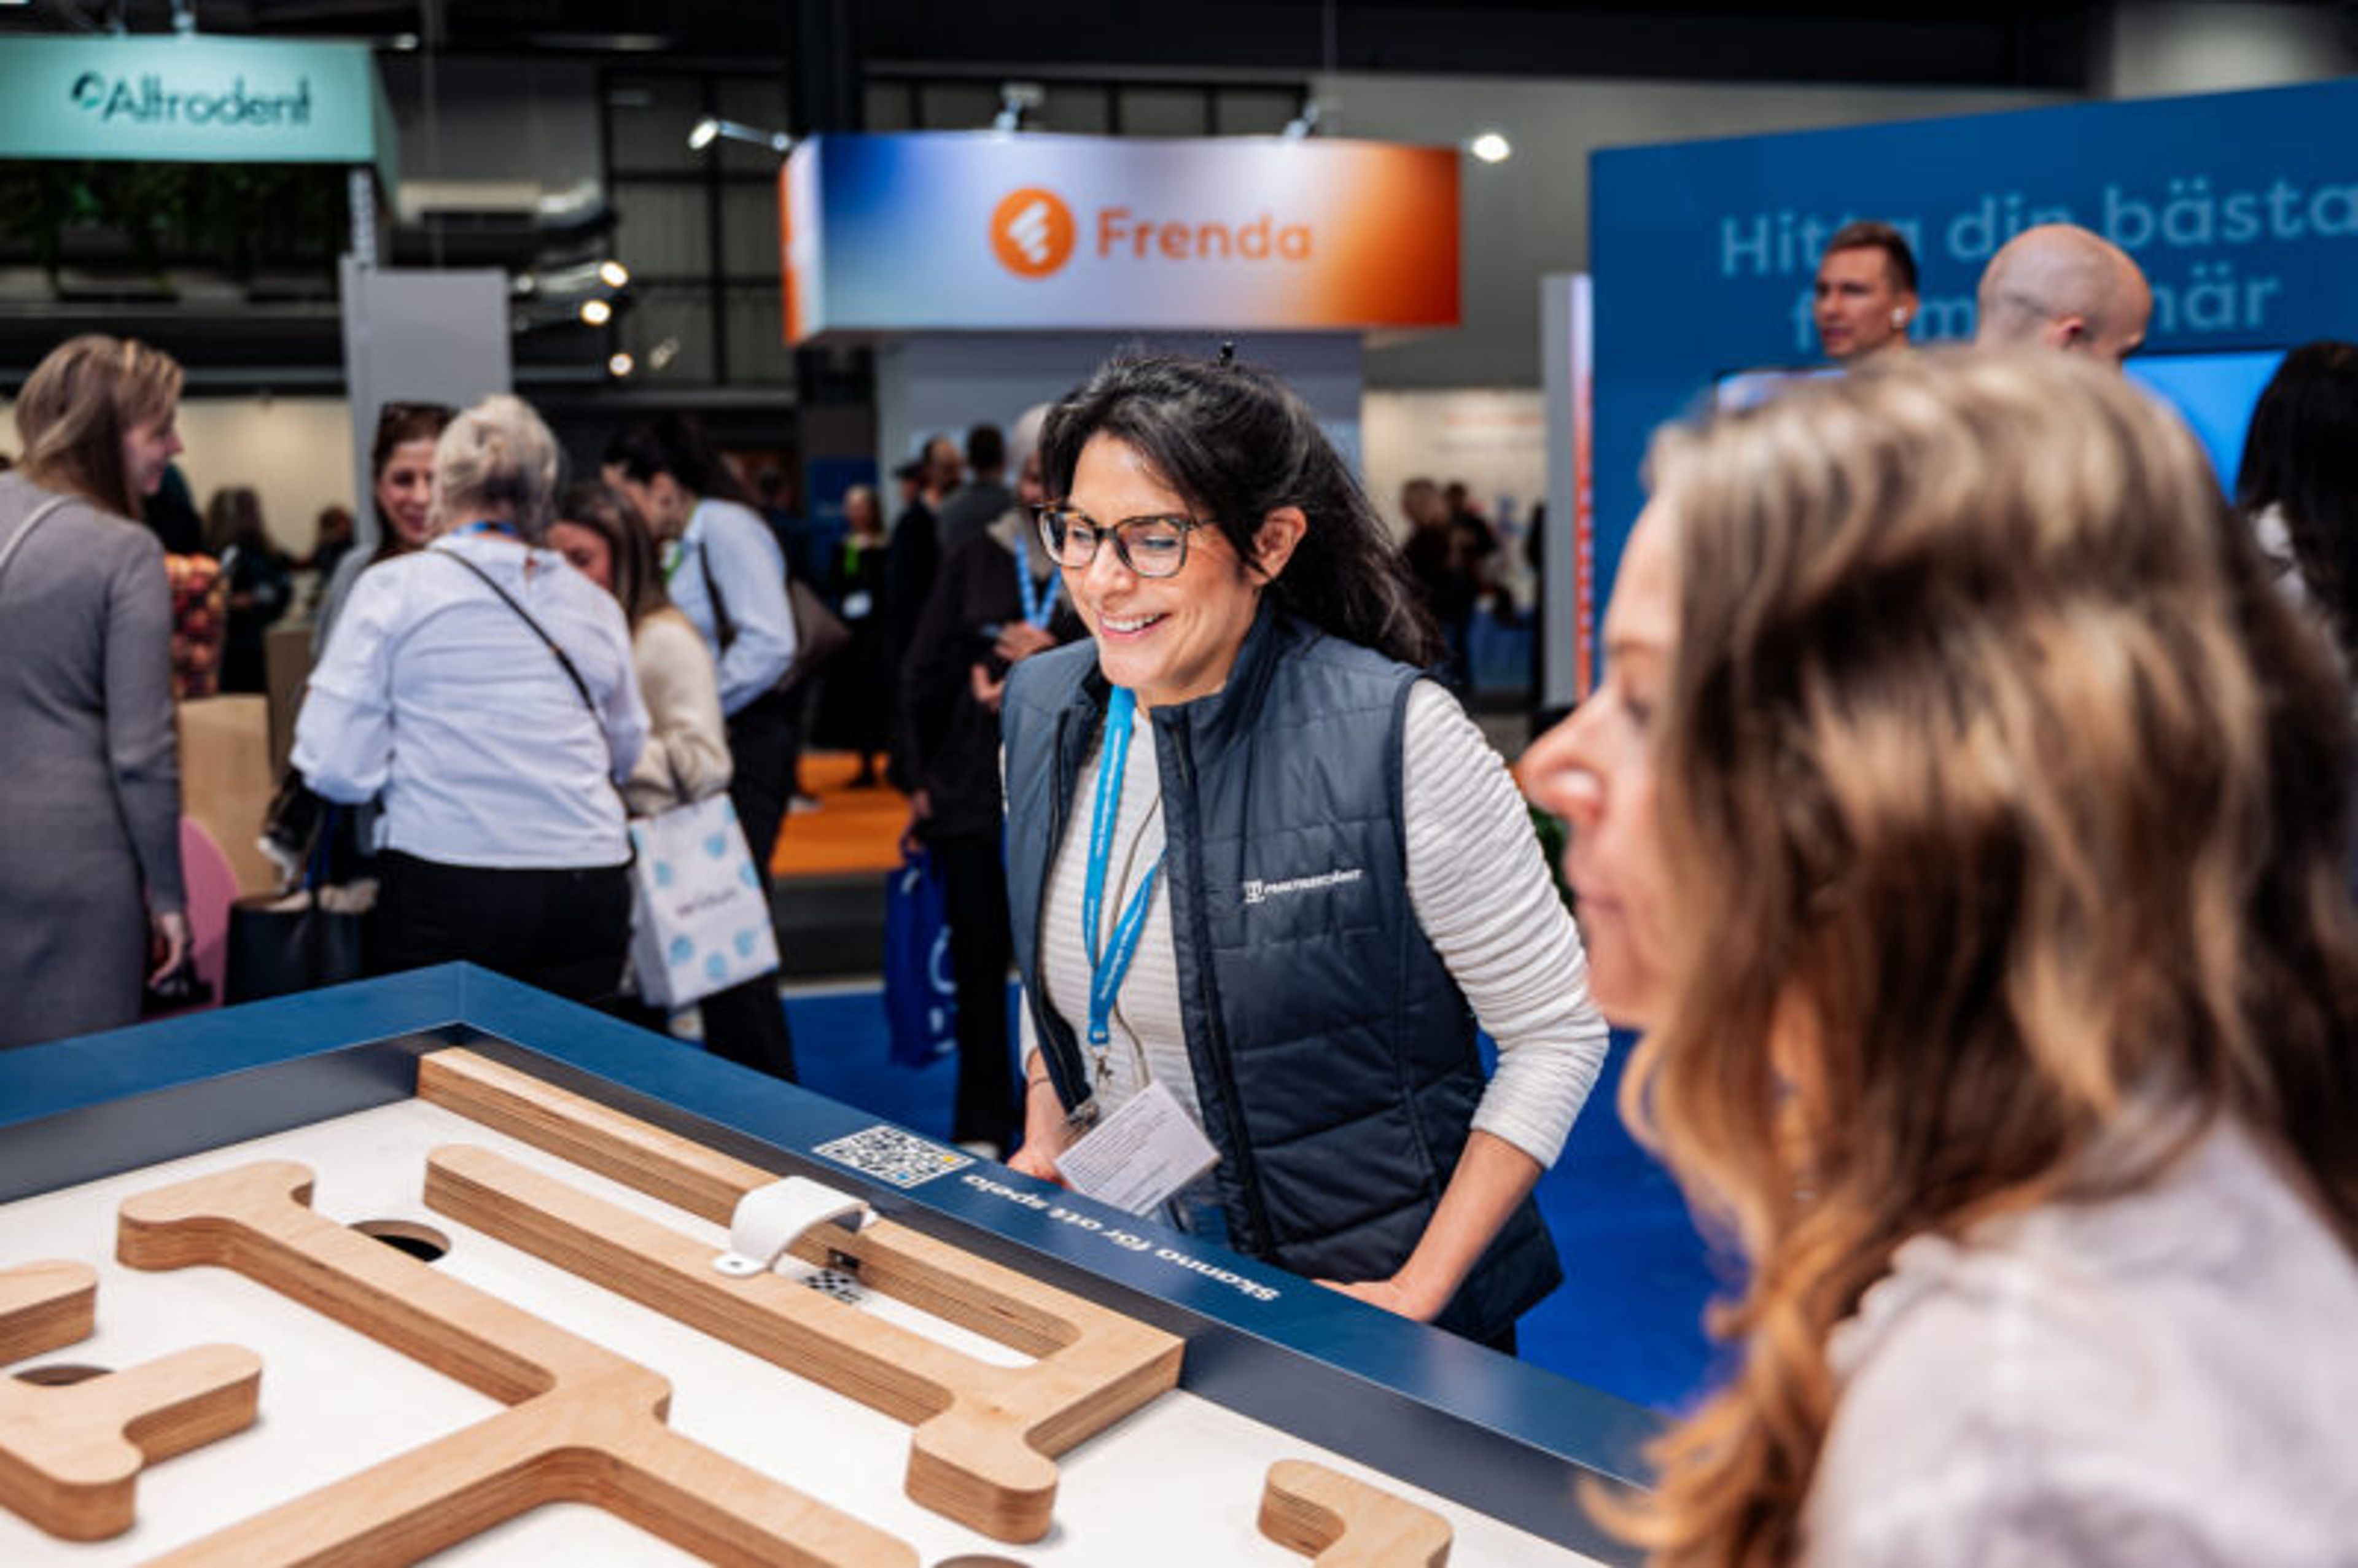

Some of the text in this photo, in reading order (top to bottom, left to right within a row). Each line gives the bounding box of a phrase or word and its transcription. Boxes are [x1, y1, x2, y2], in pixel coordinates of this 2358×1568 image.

[103, 69, 311, 125] Altrodent
[1097, 206, 1312, 260] Frenda
[1721, 178, 2358, 276] Hit di bästa
[962, 1174, 1280, 1300] Skanna för att spela
